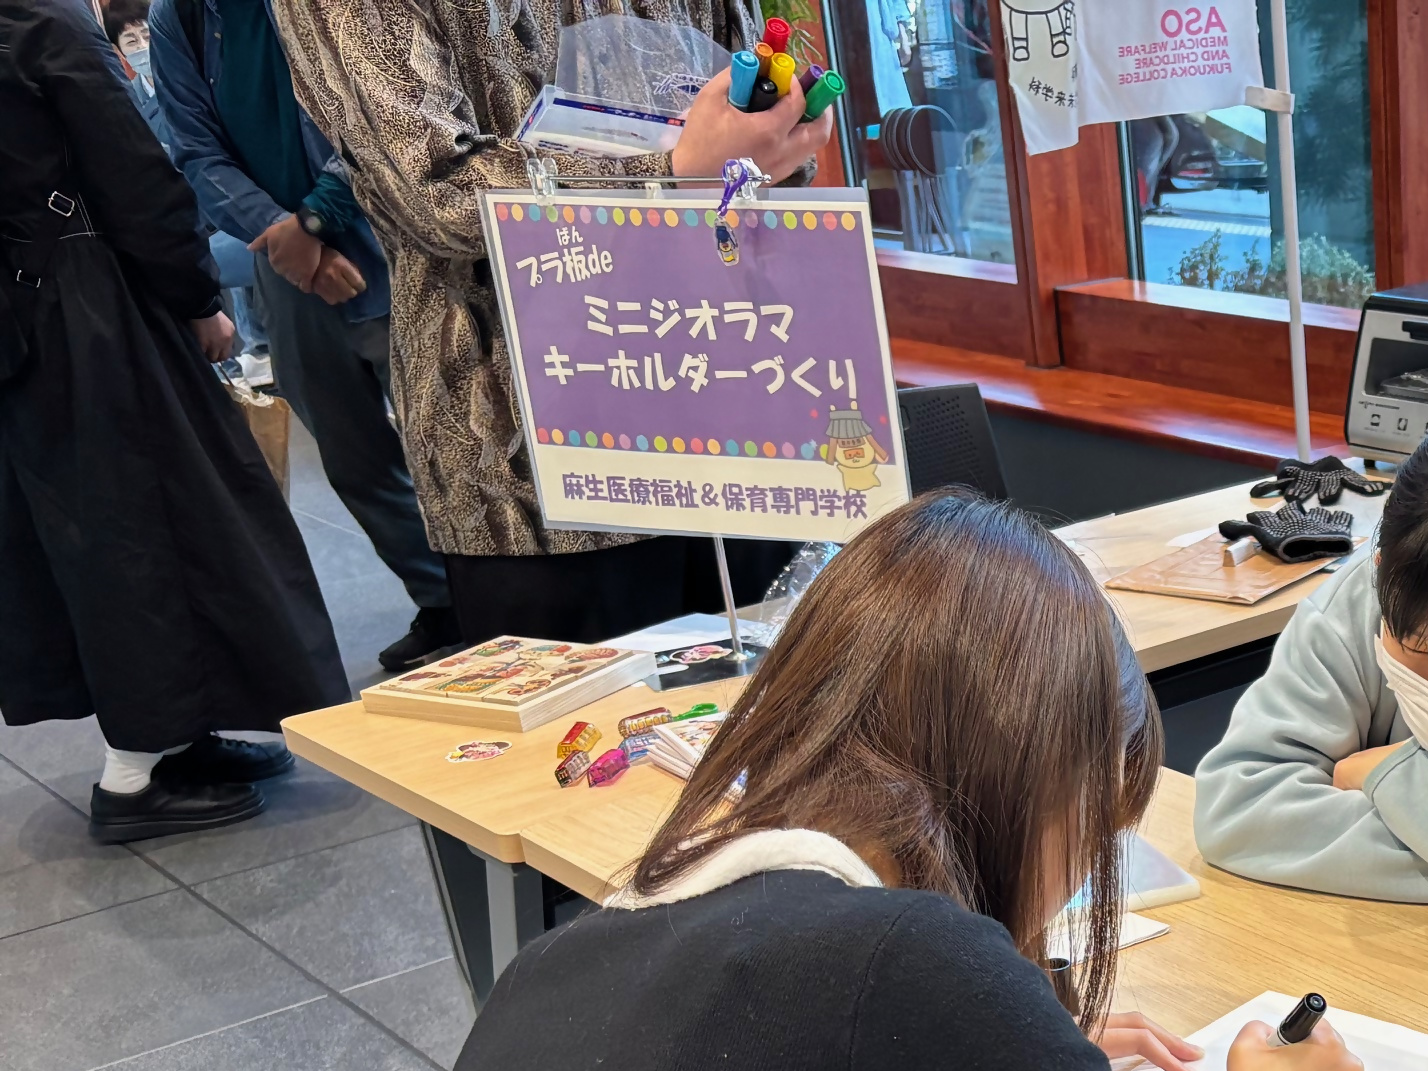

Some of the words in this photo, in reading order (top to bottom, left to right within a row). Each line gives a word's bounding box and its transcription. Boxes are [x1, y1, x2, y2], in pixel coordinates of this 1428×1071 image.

[556, 226, 583, 245] ほん
[584, 295, 794, 343] ミニジオラマ
[543, 345, 857, 399] キーホルダーづくり
